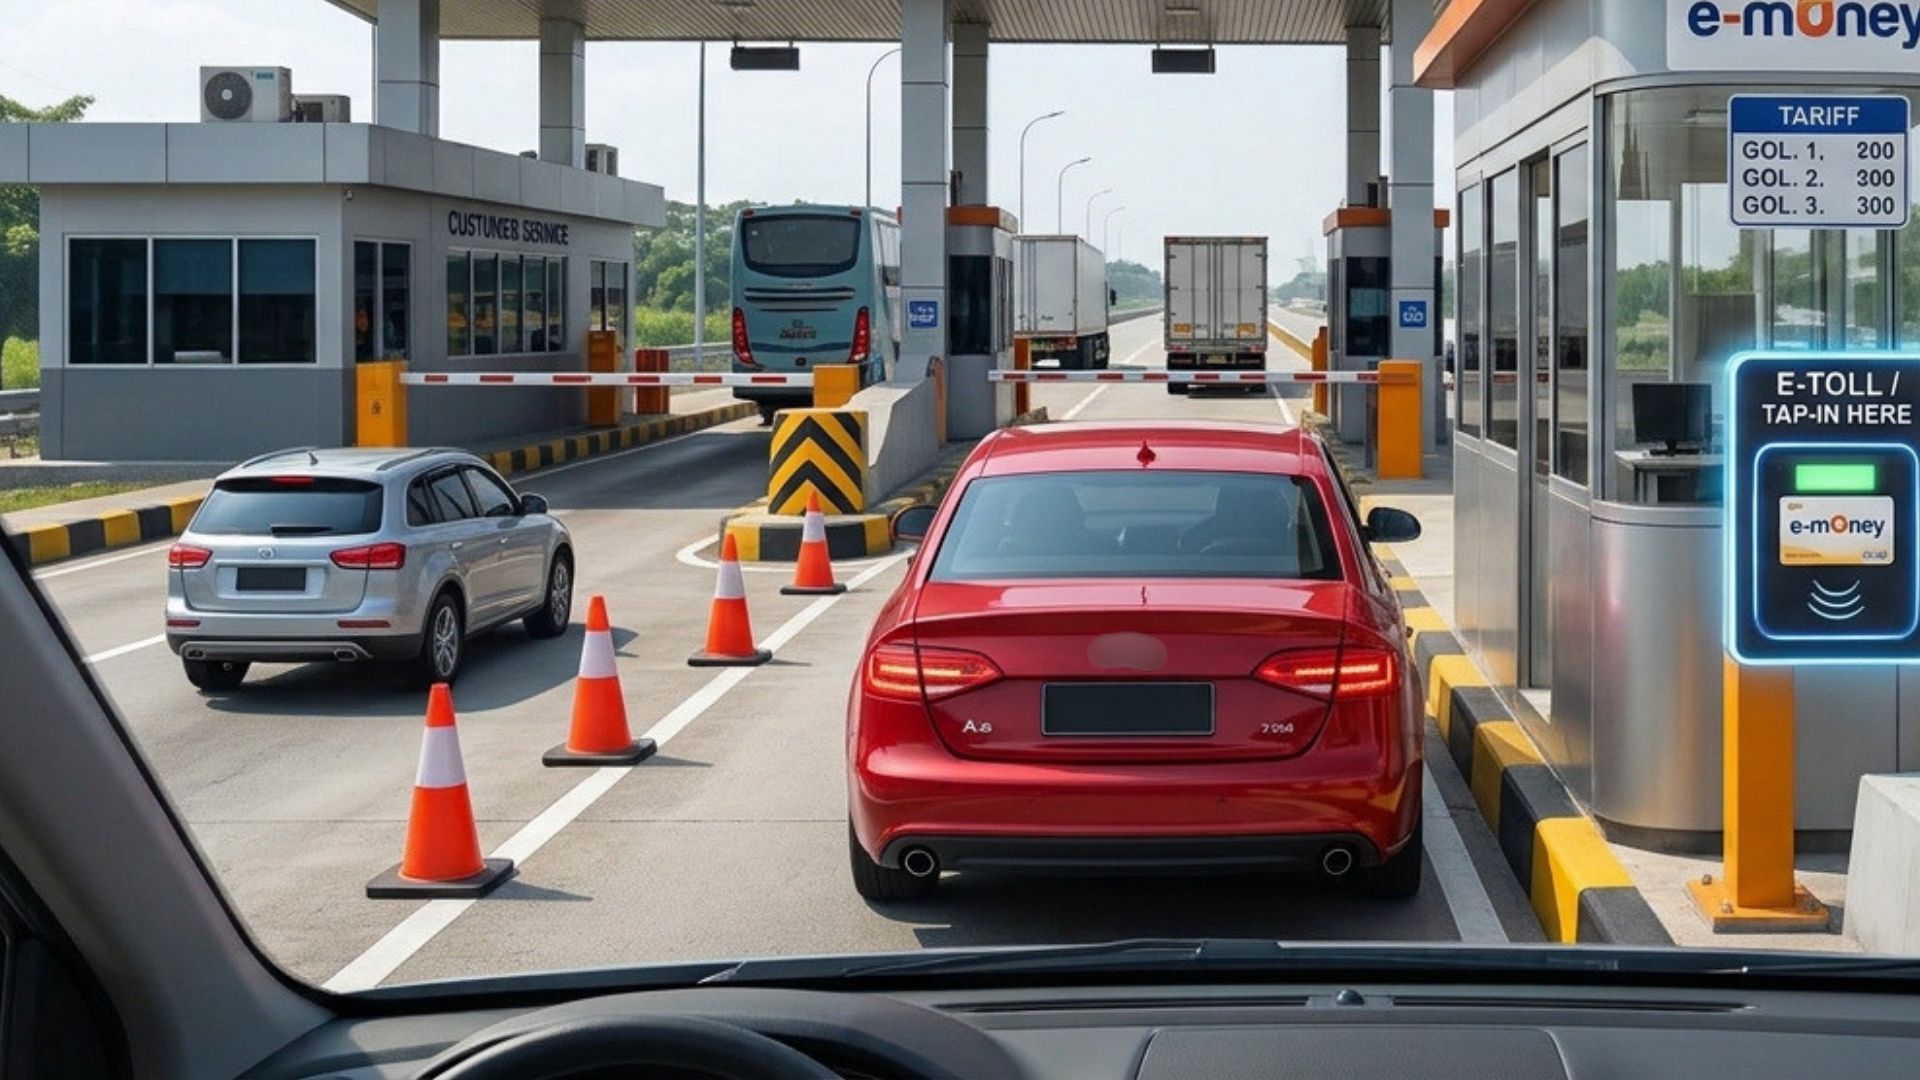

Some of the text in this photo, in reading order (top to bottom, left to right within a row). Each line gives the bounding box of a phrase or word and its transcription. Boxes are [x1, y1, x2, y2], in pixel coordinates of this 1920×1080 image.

[1688, 0, 1920, 49] e-money
[1778, 106, 1860, 126] TARIFF
[1742, 140, 1895, 160] GOL. 1. 200
[1742, 168, 1895, 187] GOL. 2. 300
[1742, 196, 1895, 215] GOL. 3. 300
[1777, 370, 1900, 397] E-TOLL /
[1762, 403, 1912, 424] TAP-IN HERE
[1790, 514, 1885, 538] e-money
